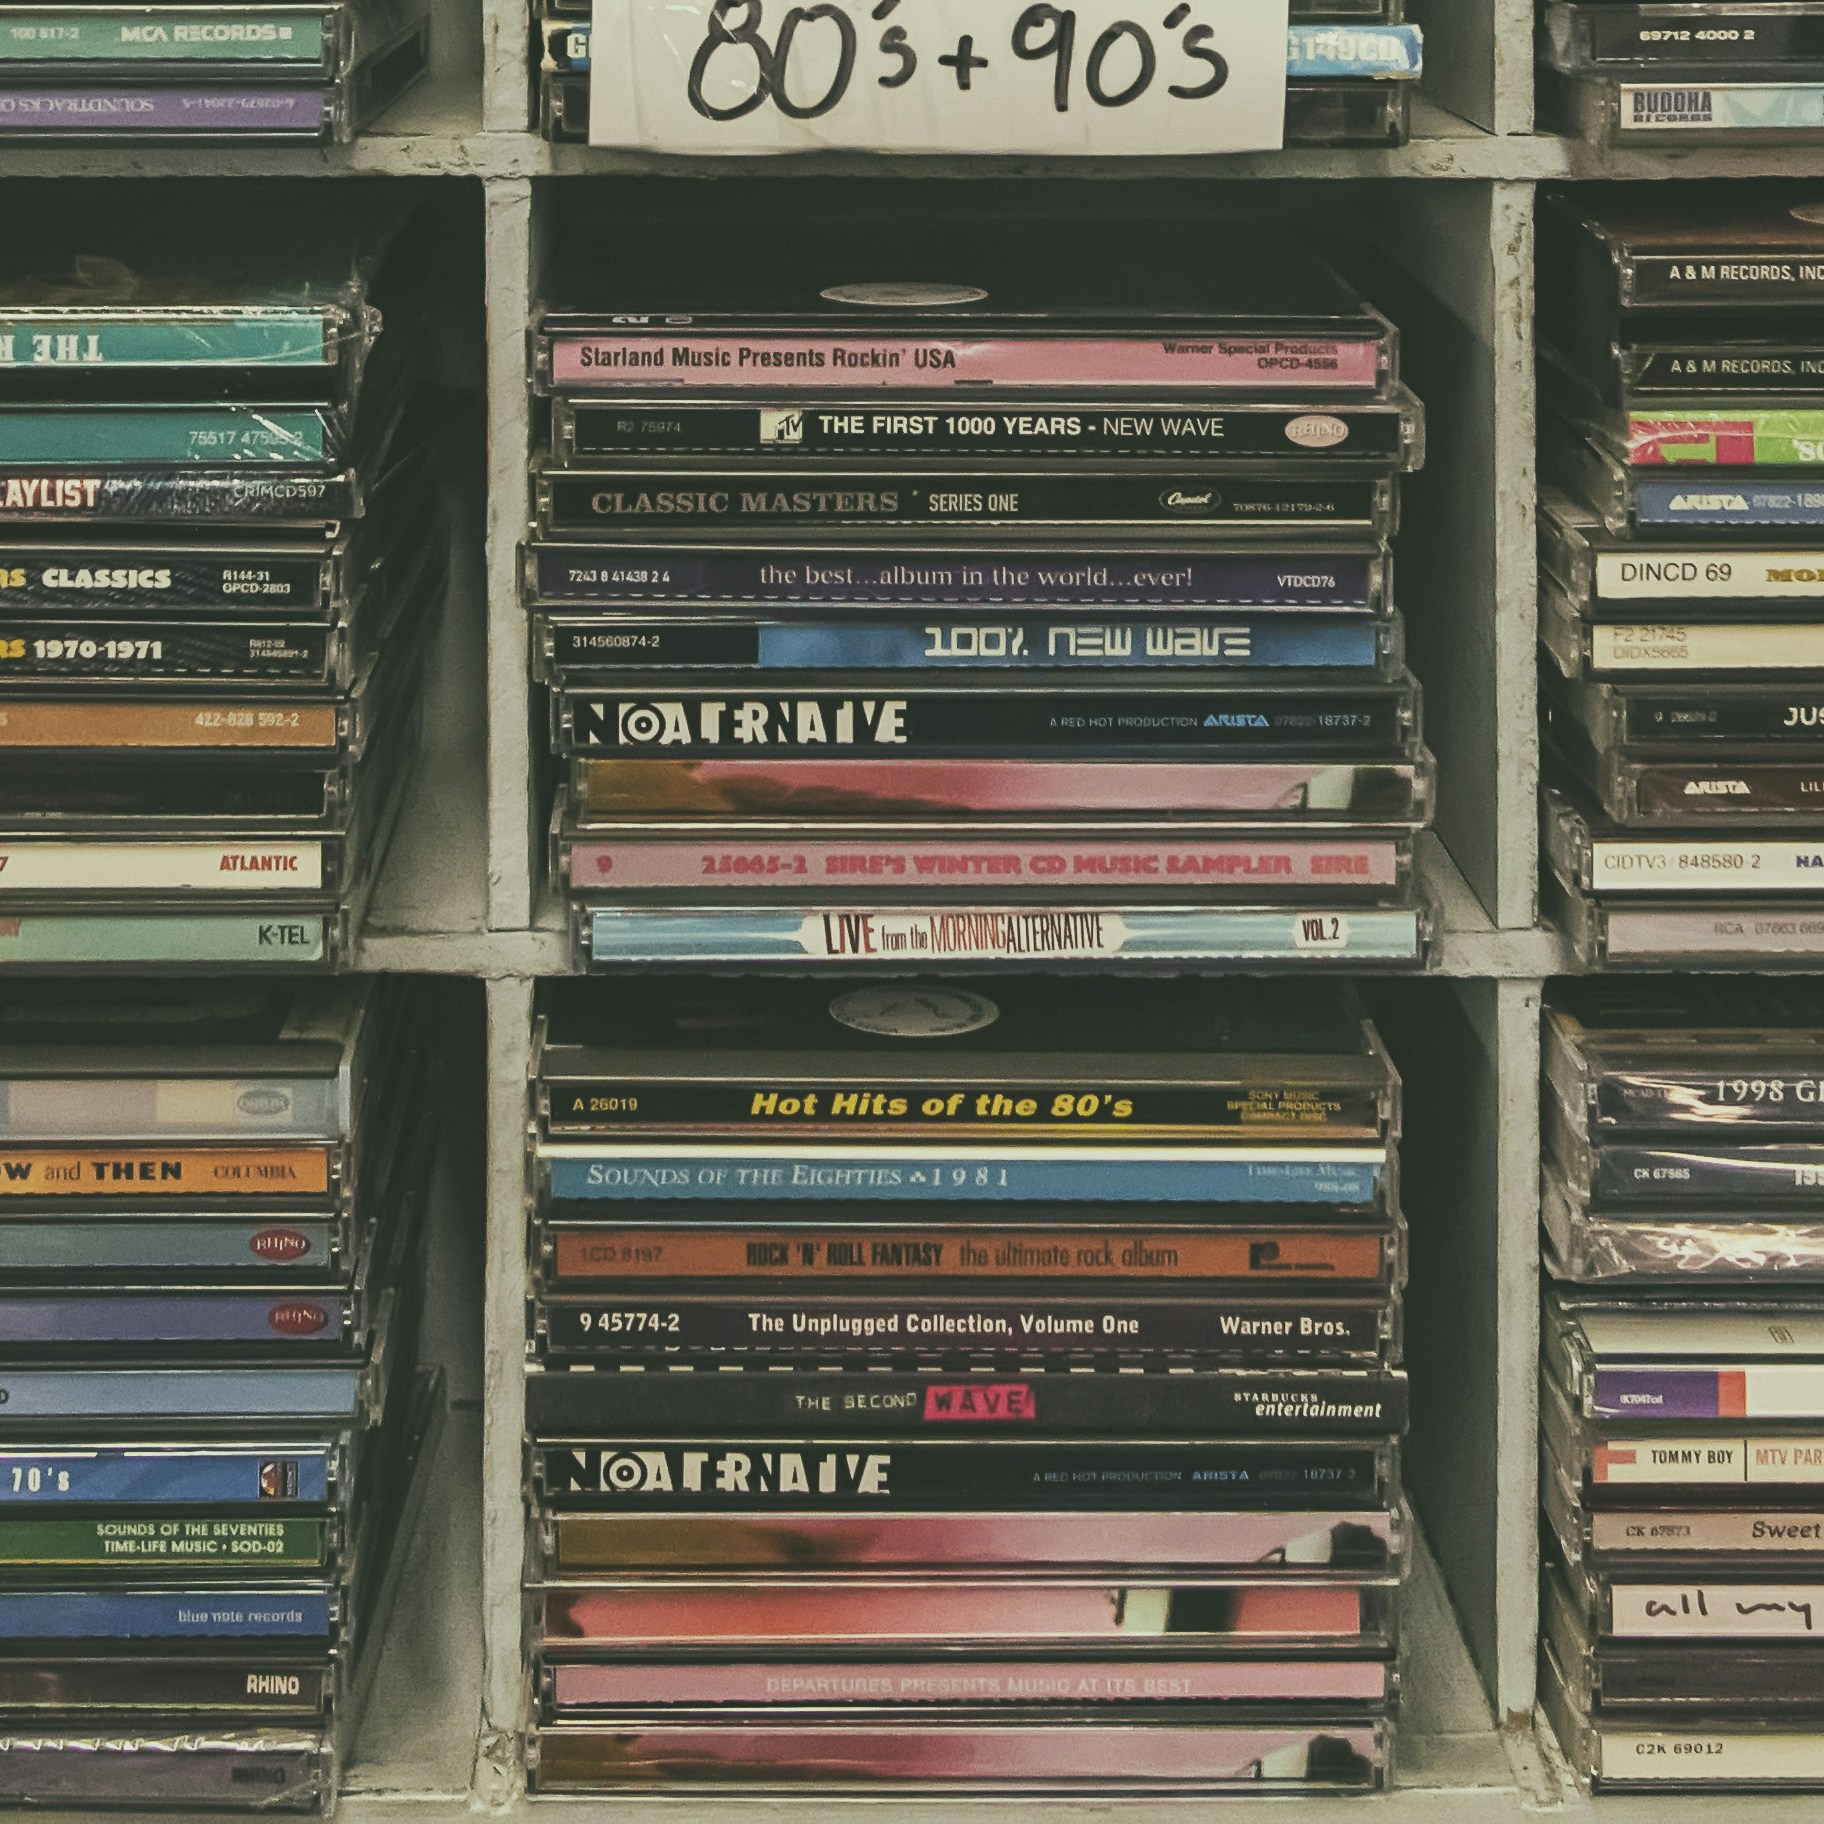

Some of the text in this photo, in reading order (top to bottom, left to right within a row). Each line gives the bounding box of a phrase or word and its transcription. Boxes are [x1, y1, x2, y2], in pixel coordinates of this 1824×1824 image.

[1011, 2, 1229, 113] 90's
[580, 345, 957, 370] Starland Music Presents Rockin' USA
[219, 855, 298, 872] ATLANTIC
[258, 925, 310, 946] K-TEL
[1301, 917, 1339, 942] VOL.2
[751, 1093, 1133, 1119] Hot Hits of the 80's
[1645, 1593, 1708, 1618] all
[1736, 1601, 1813, 1629] my
